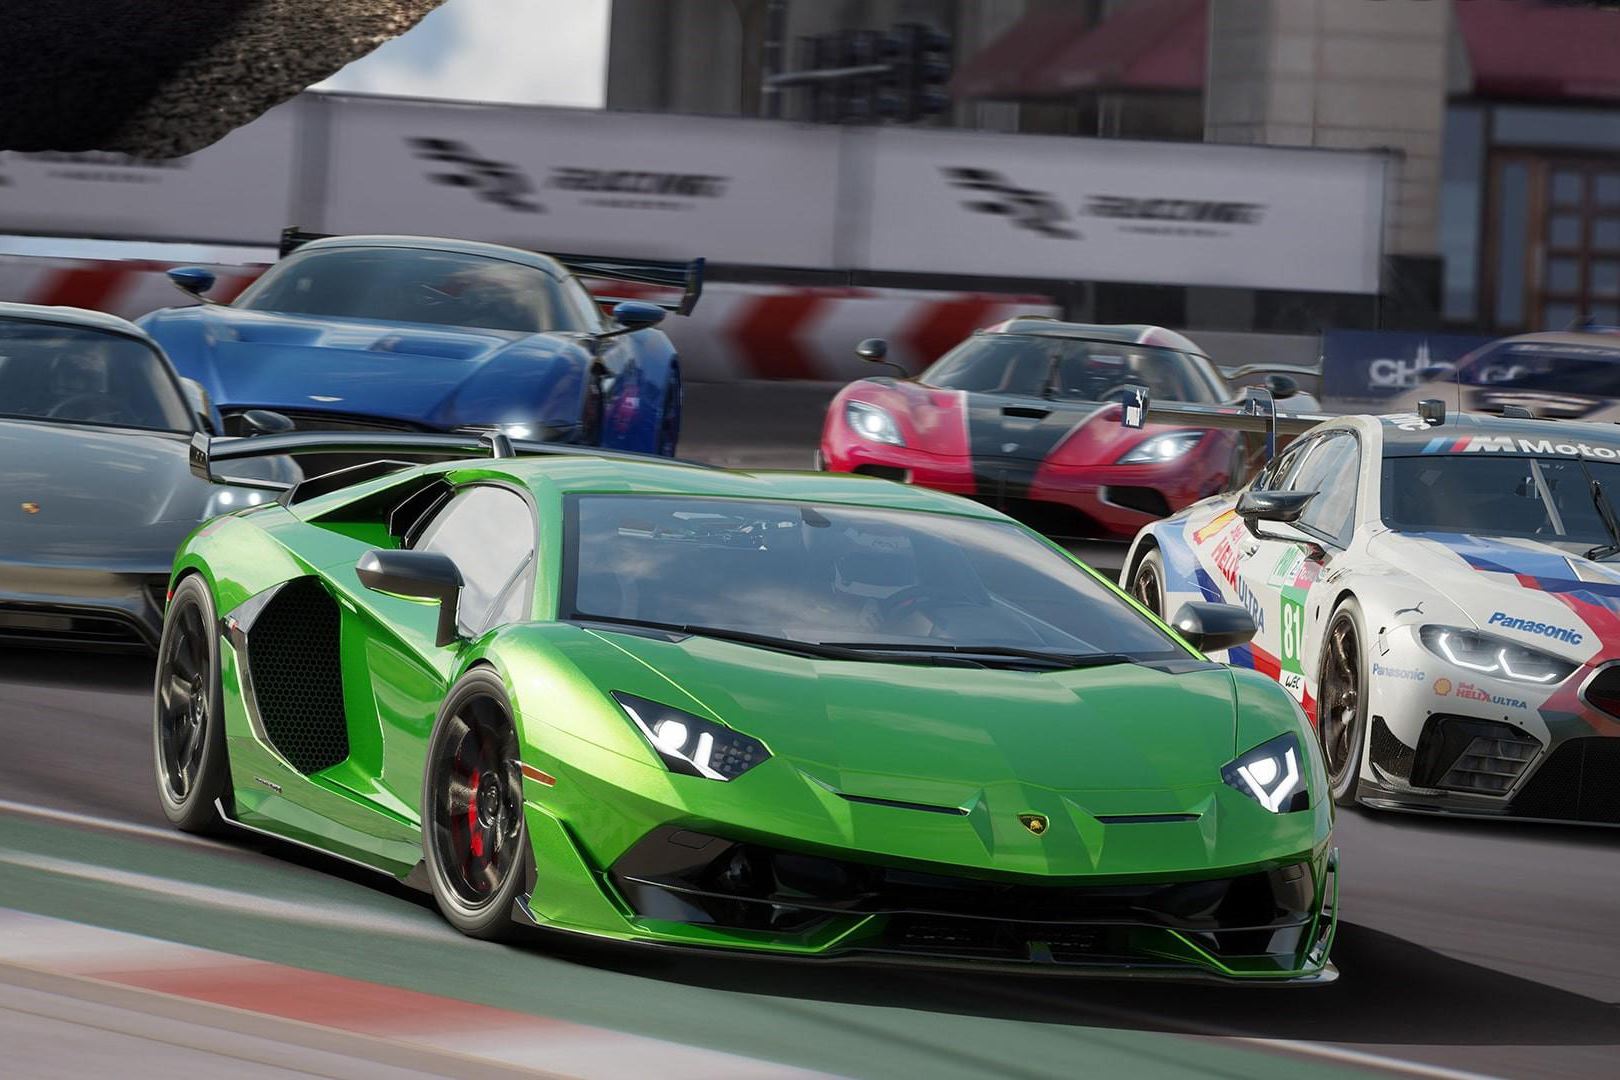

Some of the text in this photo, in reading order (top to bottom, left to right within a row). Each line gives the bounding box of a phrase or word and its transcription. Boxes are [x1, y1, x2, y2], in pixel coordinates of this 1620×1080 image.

[1465, 436, 1517, 452] M
[1239, 575, 1264, 634] ULTRA
[1284, 603, 1301, 660] 81
[1488, 612, 1583, 645] Panasonic
[1373, 663, 1426, 681] Panasonic
[1285, 676, 1301, 689] WEC
[1492, 696, 1528, 709] ULTRA
